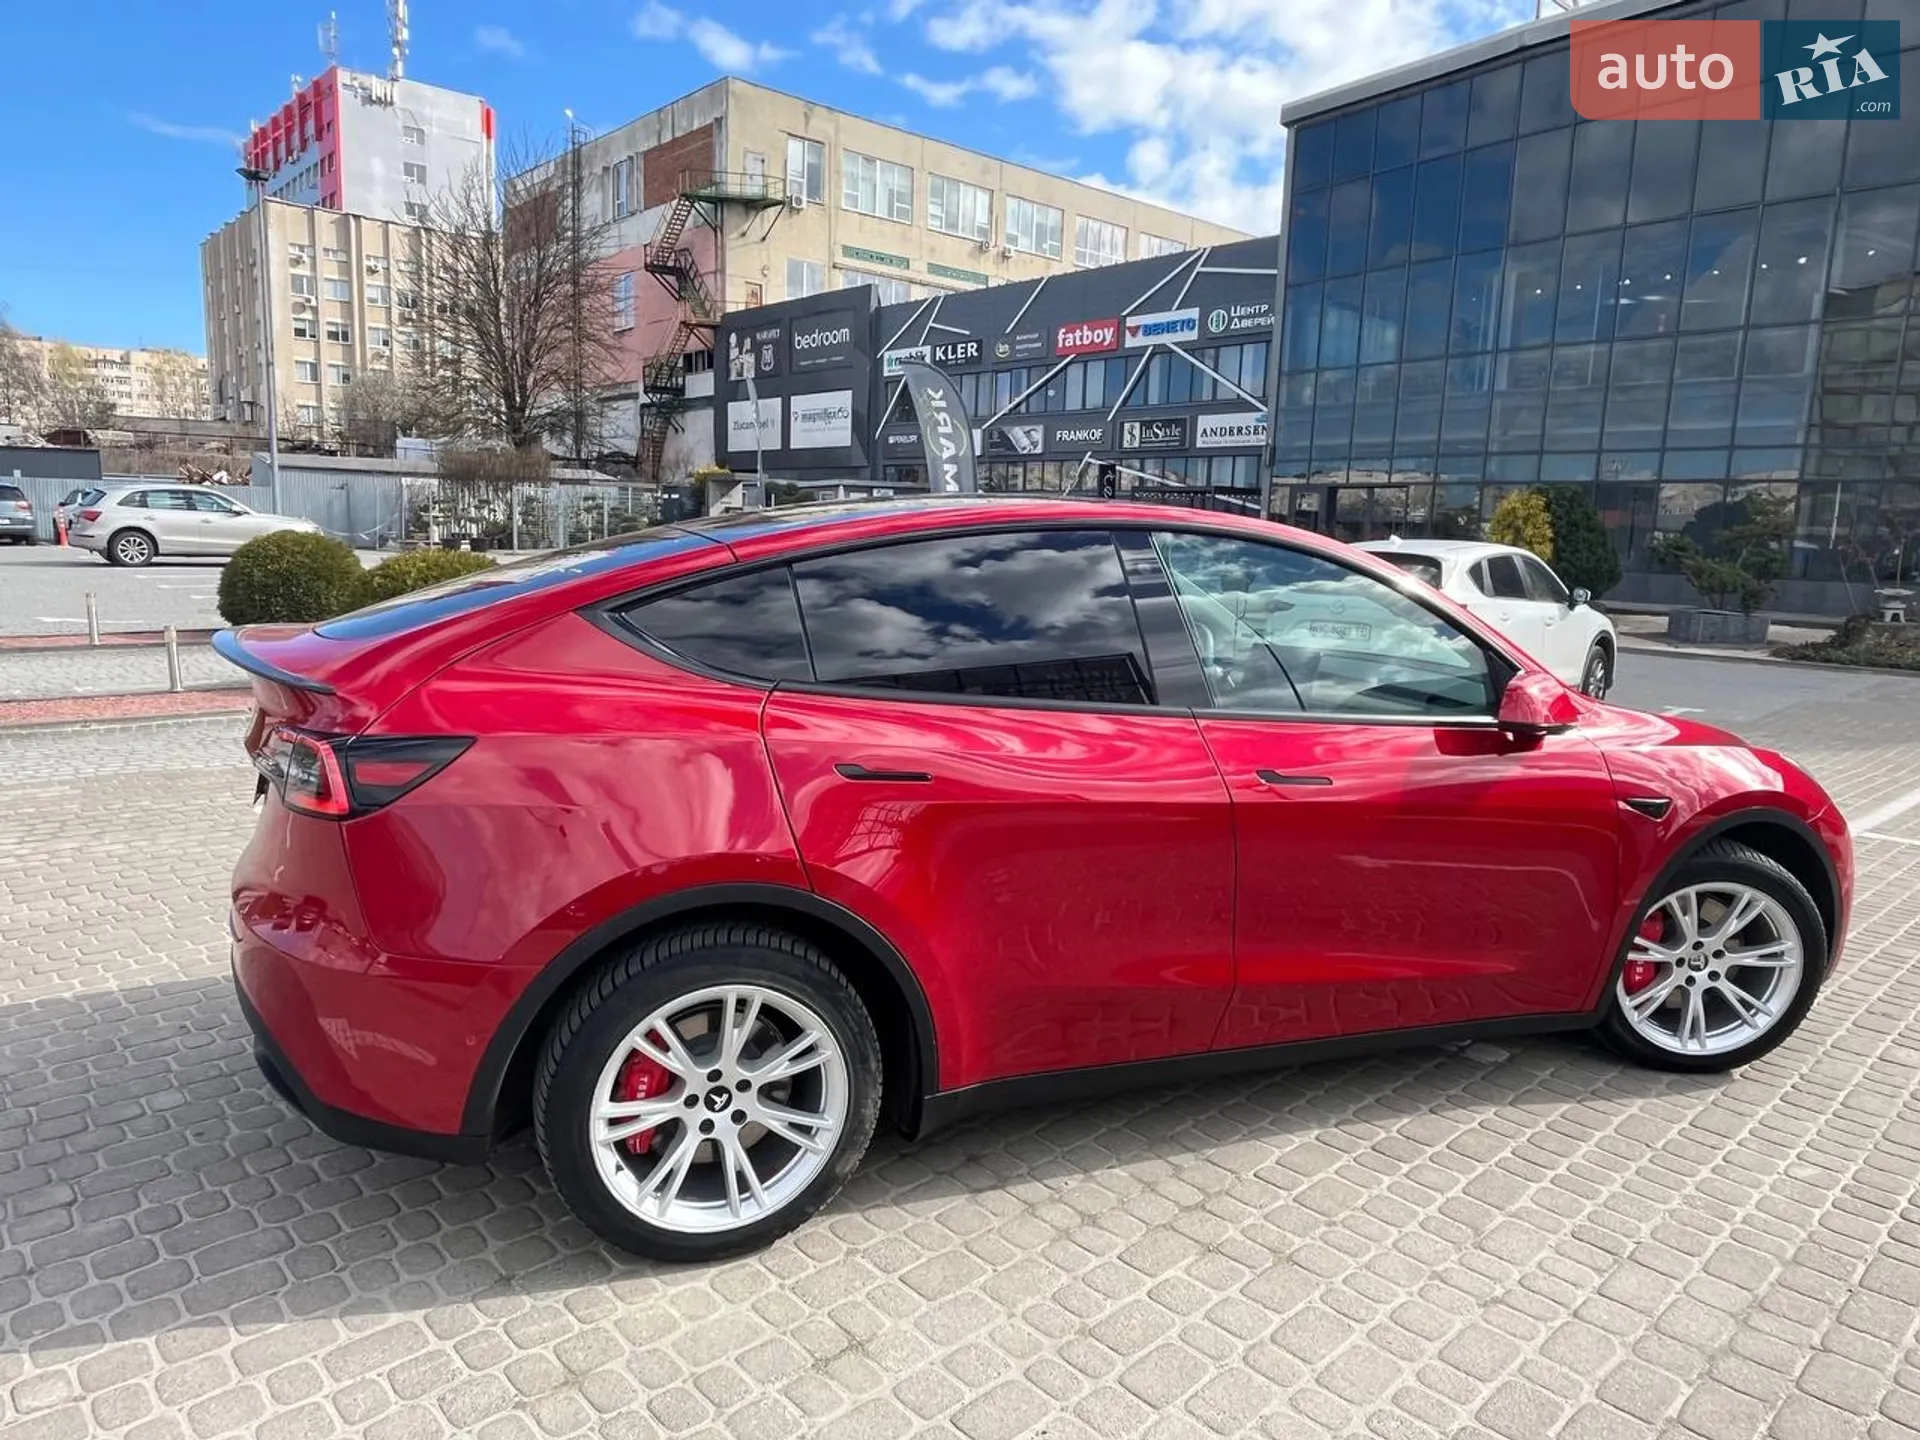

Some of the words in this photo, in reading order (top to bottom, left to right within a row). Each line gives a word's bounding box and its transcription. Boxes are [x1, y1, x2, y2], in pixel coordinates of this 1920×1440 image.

[795, 327, 850, 350] bedroom
[1057, 324, 1113, 348] fatboy
[935, 342, 979, 361] KLER
[1056, 428, 1104, 441] FRANKOF
